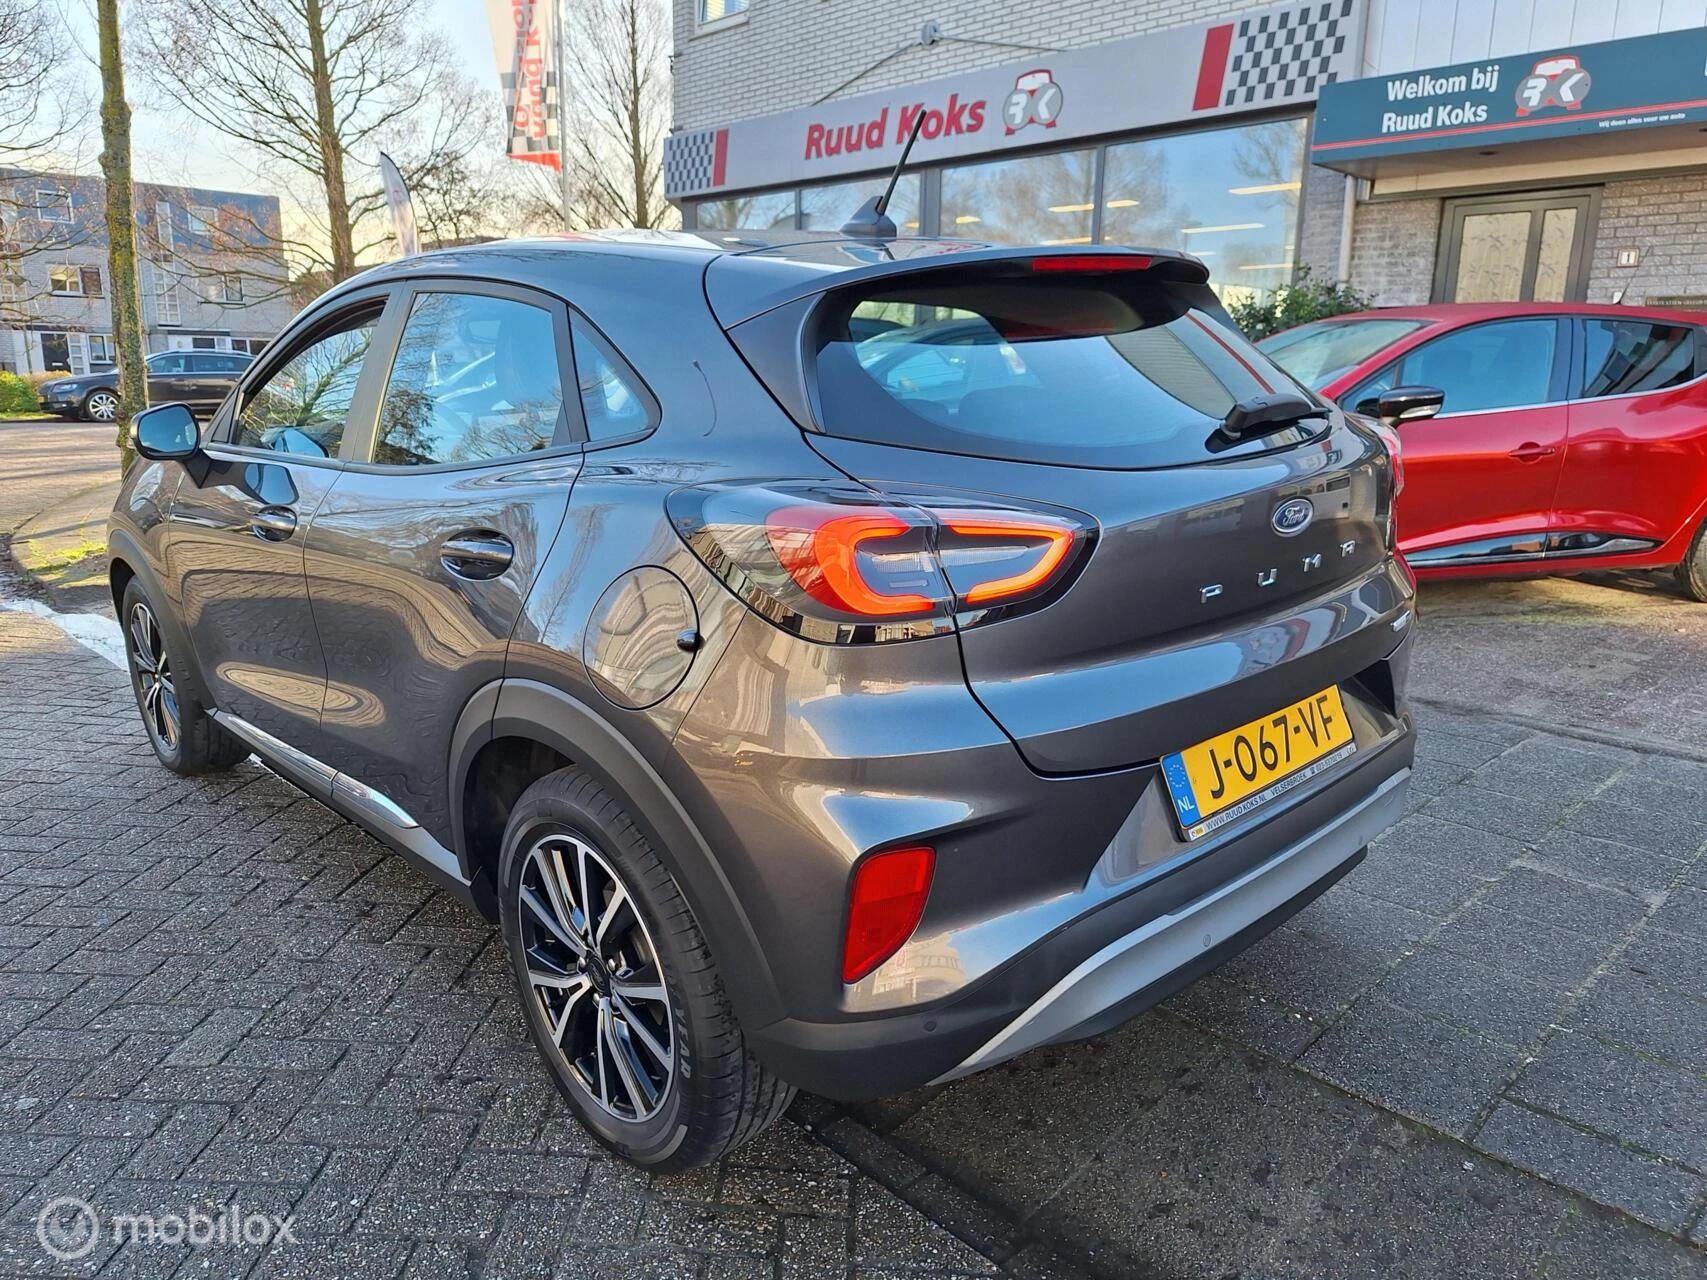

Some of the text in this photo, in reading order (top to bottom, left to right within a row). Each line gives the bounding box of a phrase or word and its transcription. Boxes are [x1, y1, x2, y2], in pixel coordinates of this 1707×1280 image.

[1387, 64, 1500, 103] Welkom bij
[804, 93, 987, 161] Ruud Koks
[1381, 101, 1488, 134] Ruud Koks
[1200, 540, 1356, 604] PUMA
[1209, 695, 1333, 799] J-067-VF
[1177, 795, 1195, 814] NL
